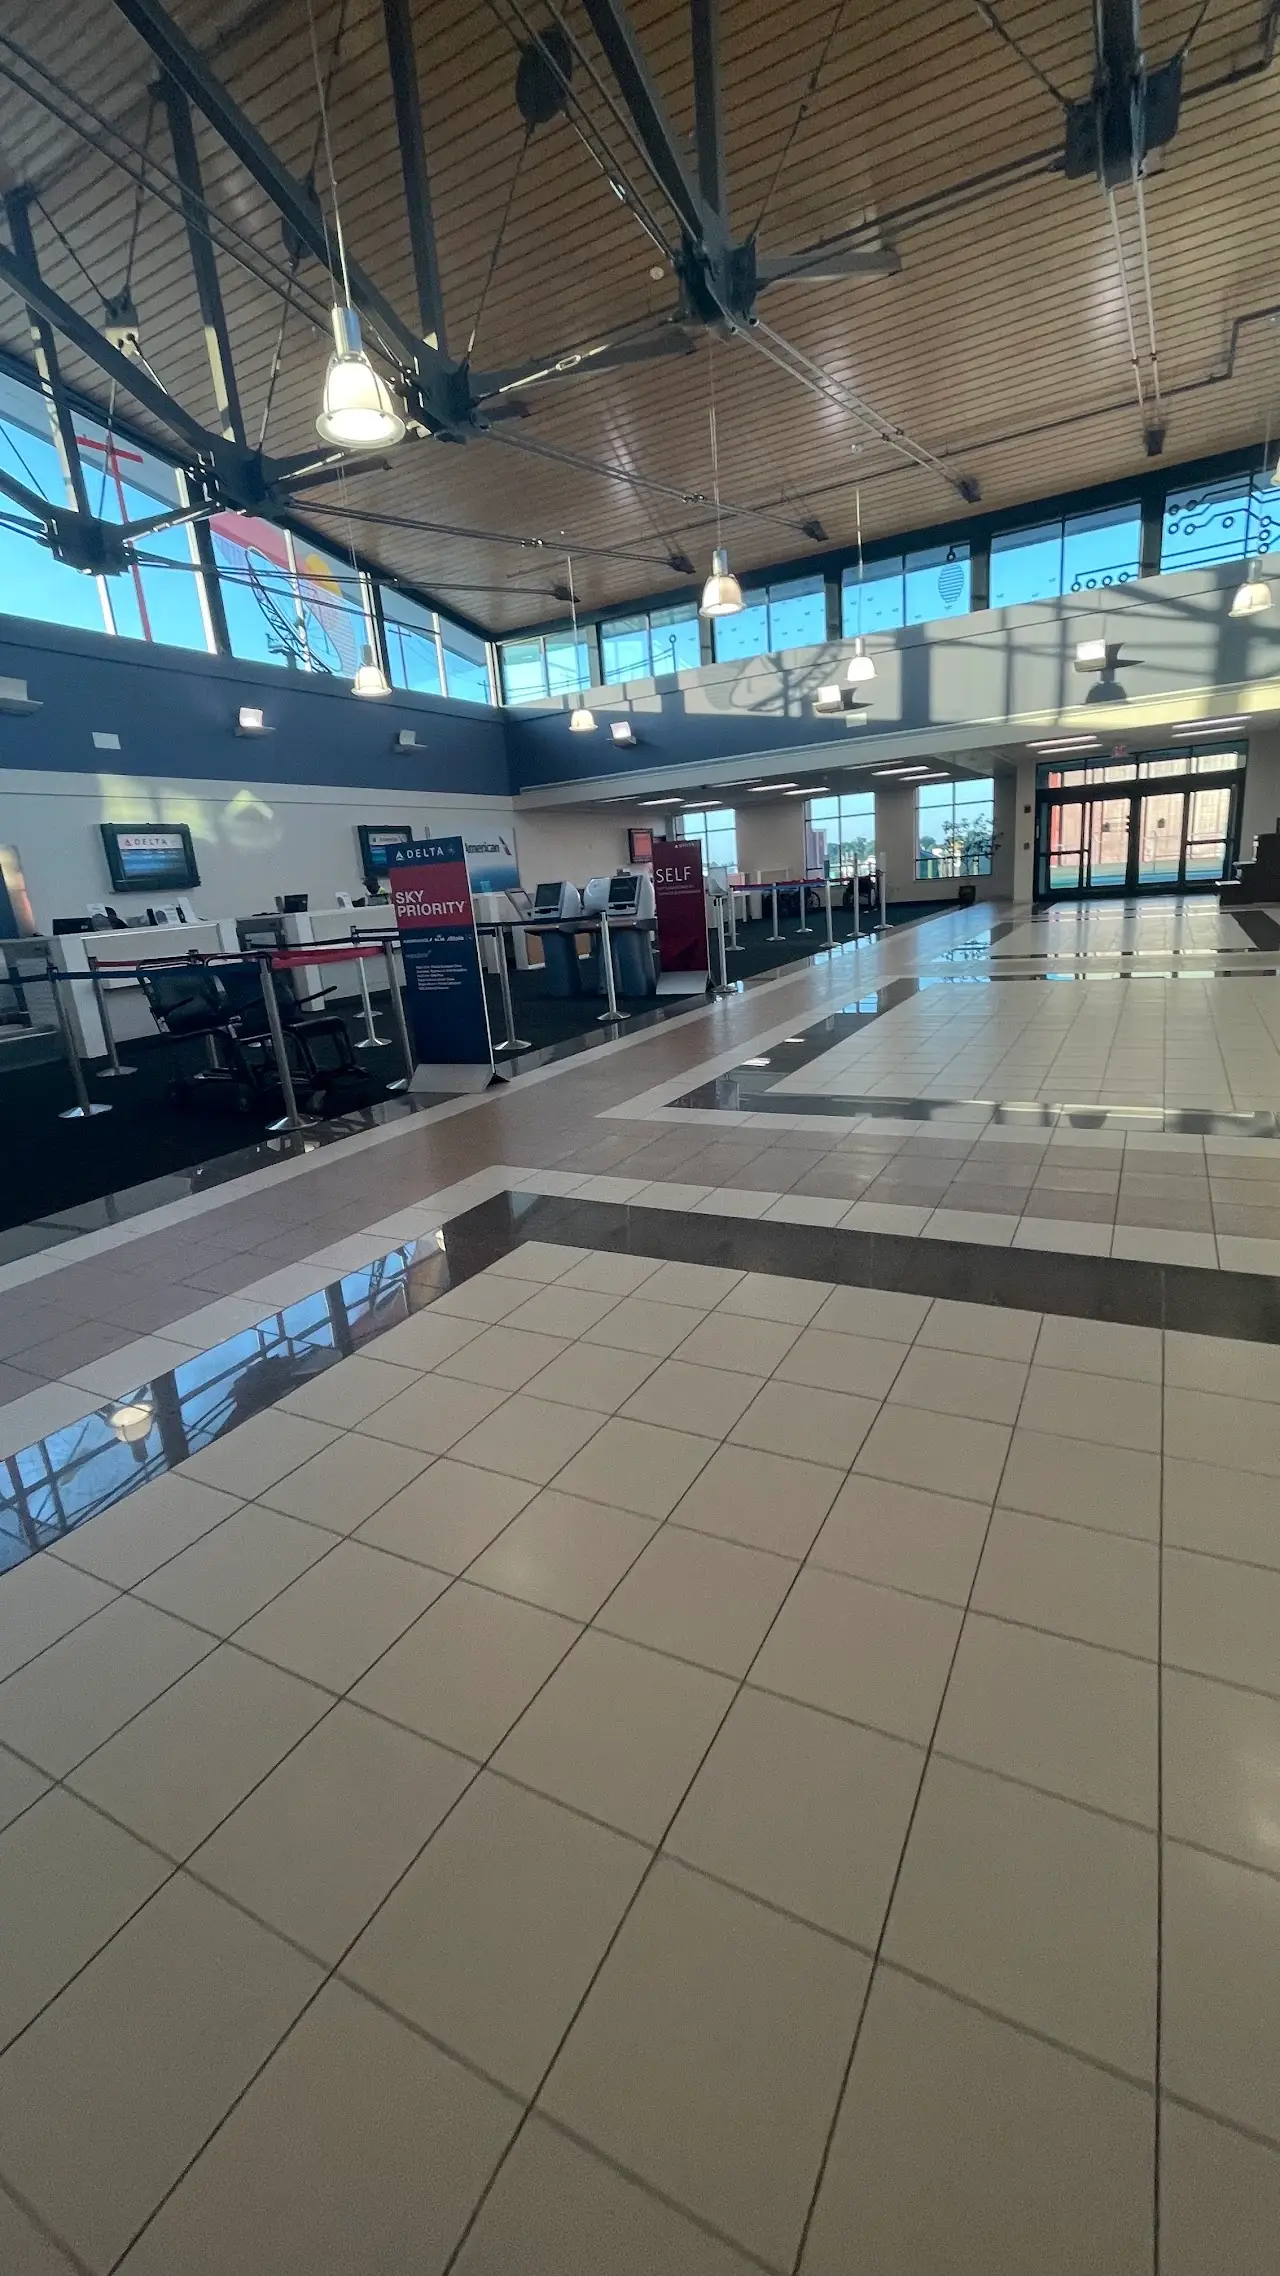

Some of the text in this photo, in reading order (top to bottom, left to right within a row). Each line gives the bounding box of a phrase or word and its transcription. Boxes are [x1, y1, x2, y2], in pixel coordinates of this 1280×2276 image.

[134, 838, 168, 846] DELTA
[406, 846, 445, 859] DELTA
[655, 866, 692, 883] SELF
[395, 890, 424, 904] SKY
[397, 901, 465, 917] PRIORITY
